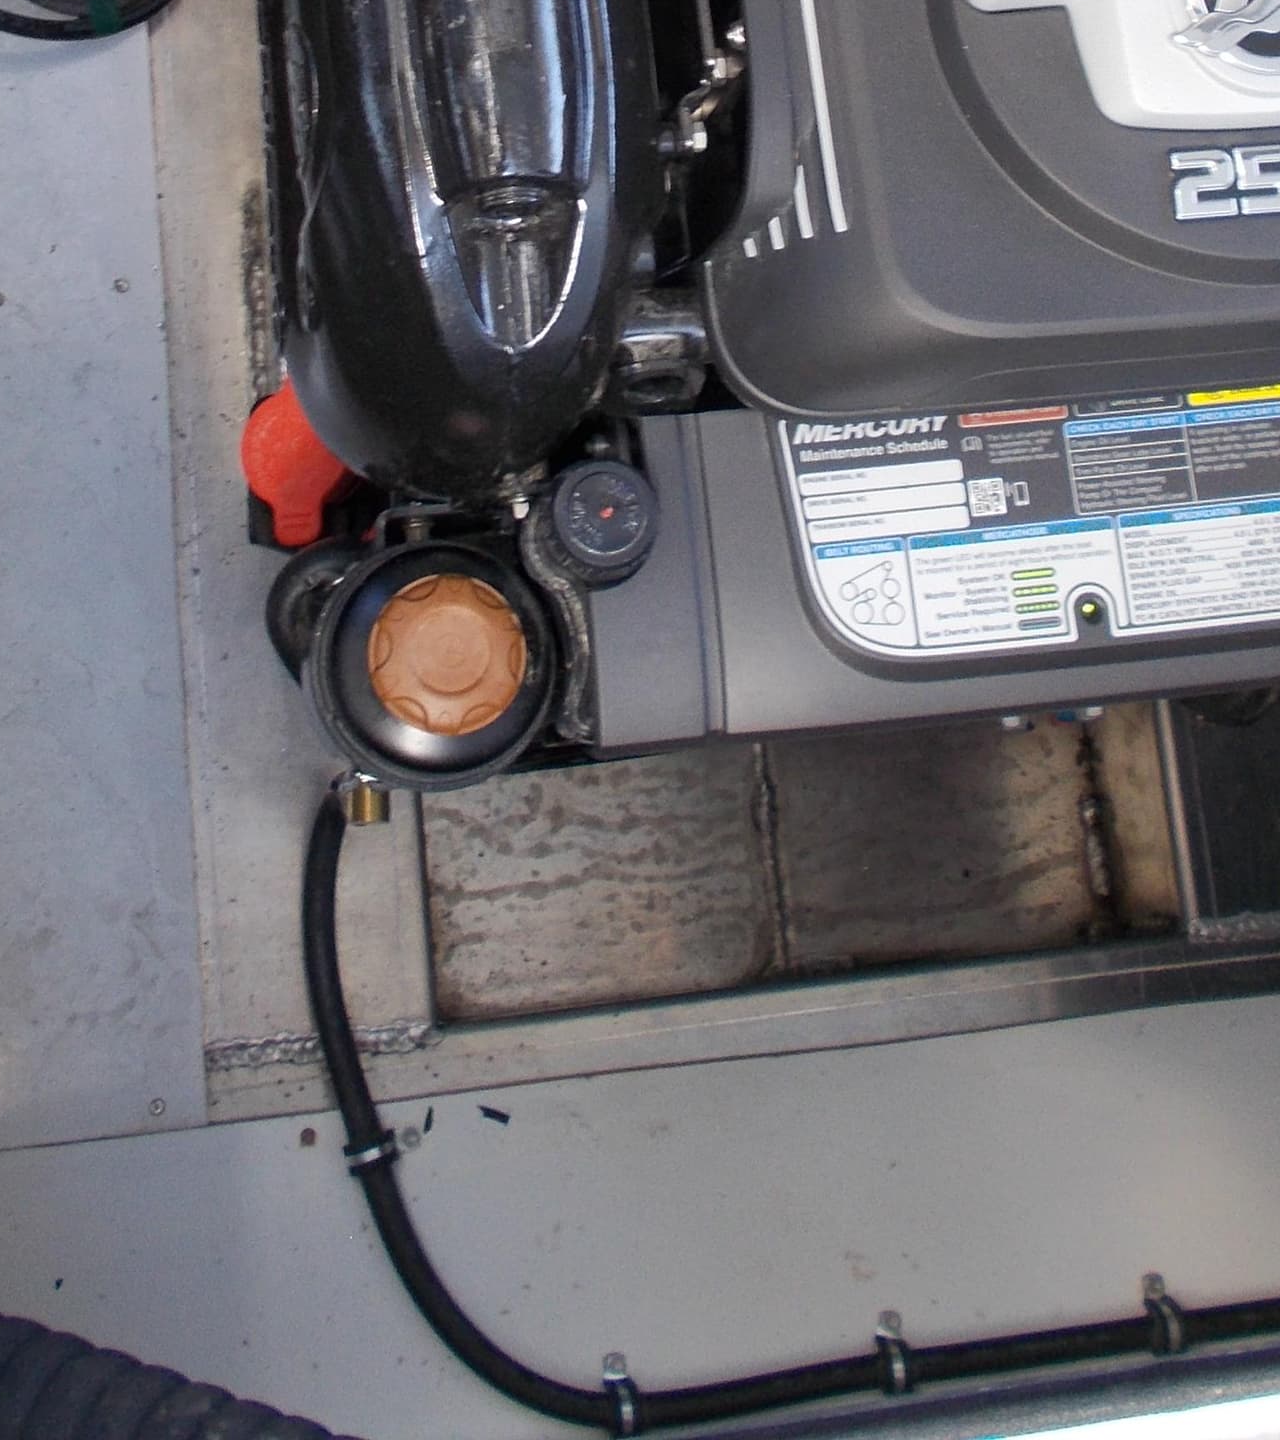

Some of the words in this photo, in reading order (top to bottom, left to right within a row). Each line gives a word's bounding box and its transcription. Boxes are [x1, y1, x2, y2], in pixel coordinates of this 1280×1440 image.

[792, 416, 948, 445] MERCURY
[799, 444, 885, 462] Maintenance
[886, 438, 948, 455] Schedule
